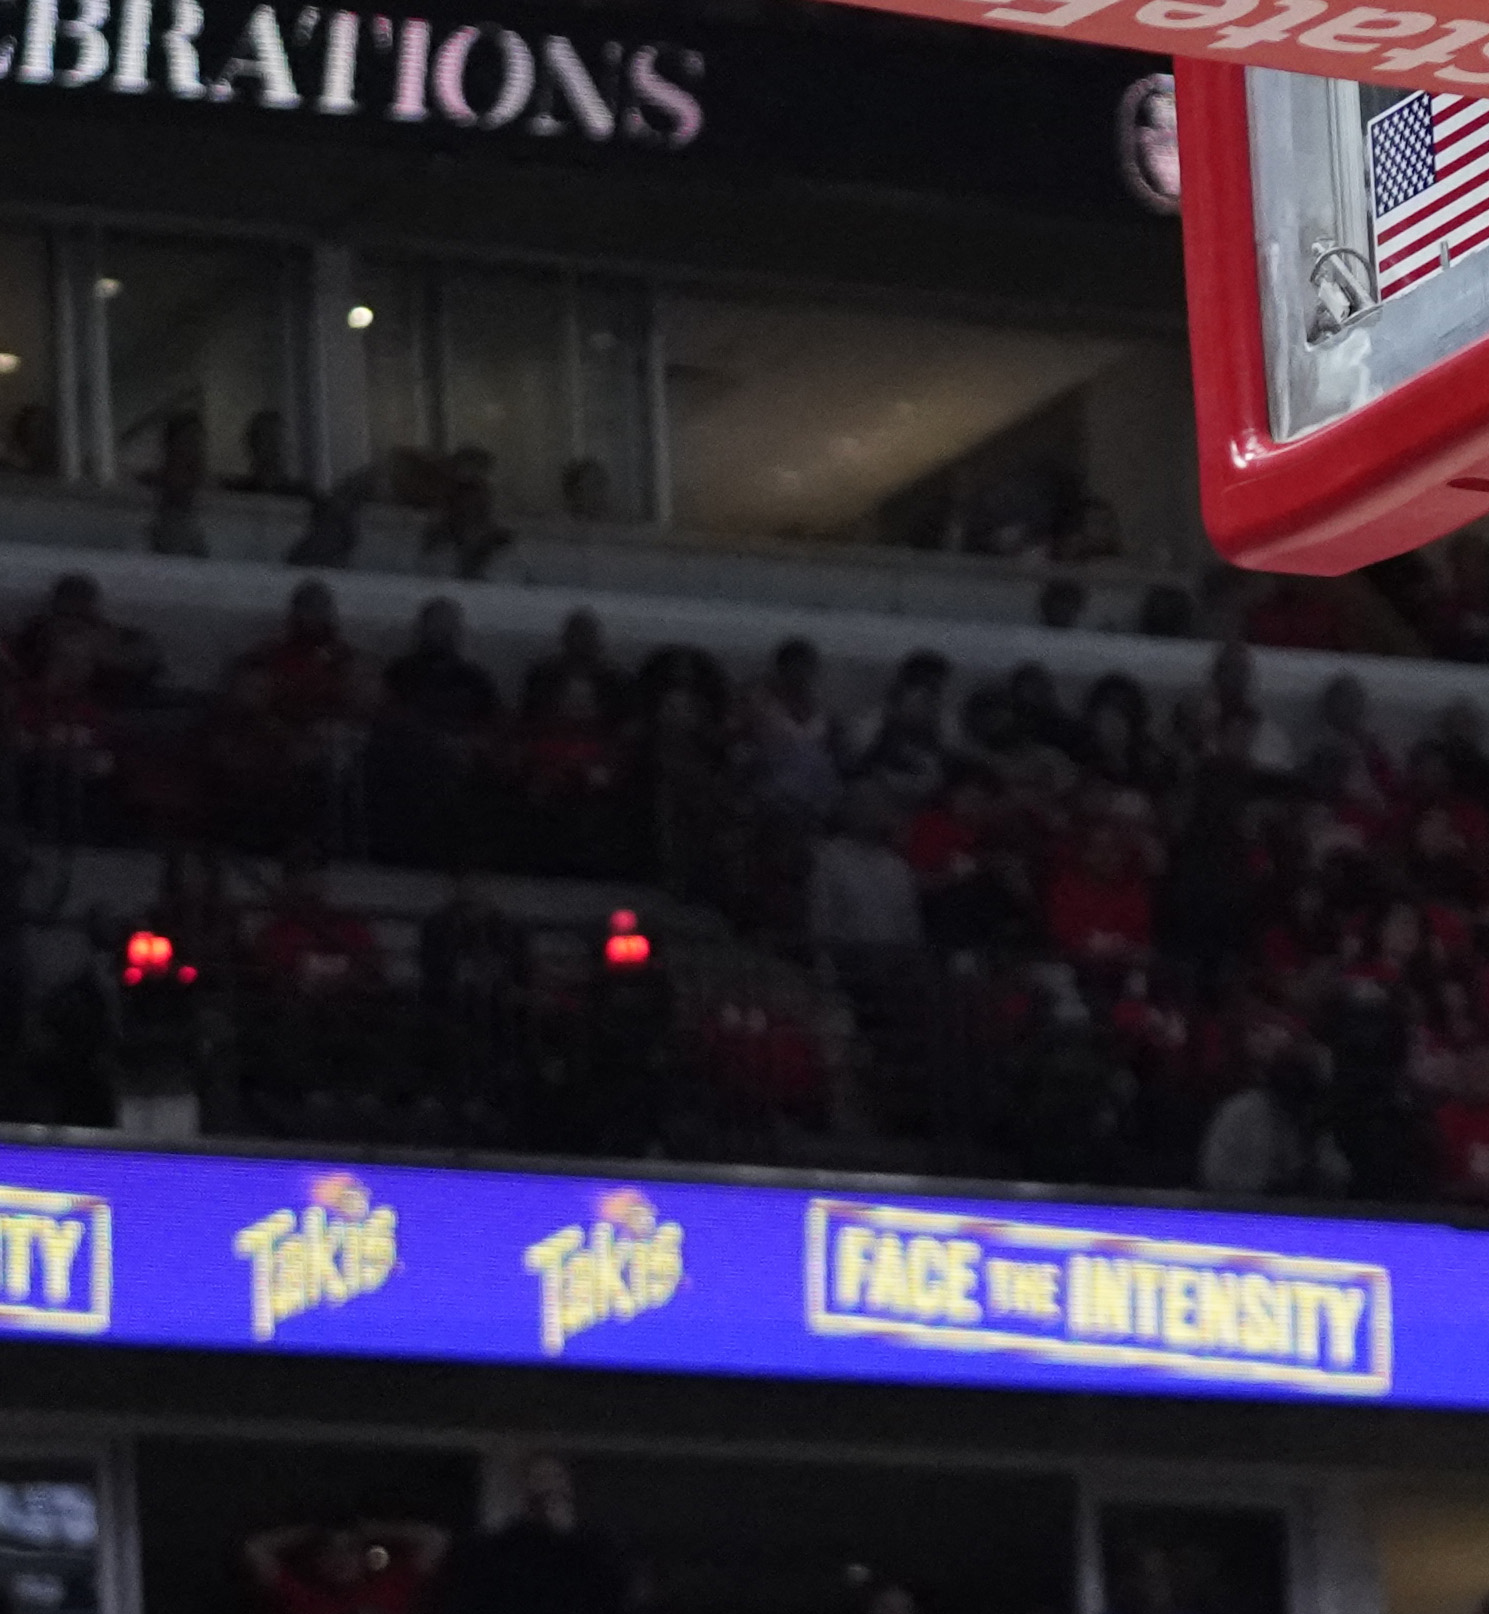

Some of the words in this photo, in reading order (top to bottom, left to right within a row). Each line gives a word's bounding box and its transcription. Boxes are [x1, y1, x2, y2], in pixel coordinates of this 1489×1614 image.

[0, 0, 706, 147] BRATIONS
[835, 1225, 983, 1324] FACE
[985, 1259, 1060, 1318] THE
[1065, 1253, 1366, 1369] INTENSITY
